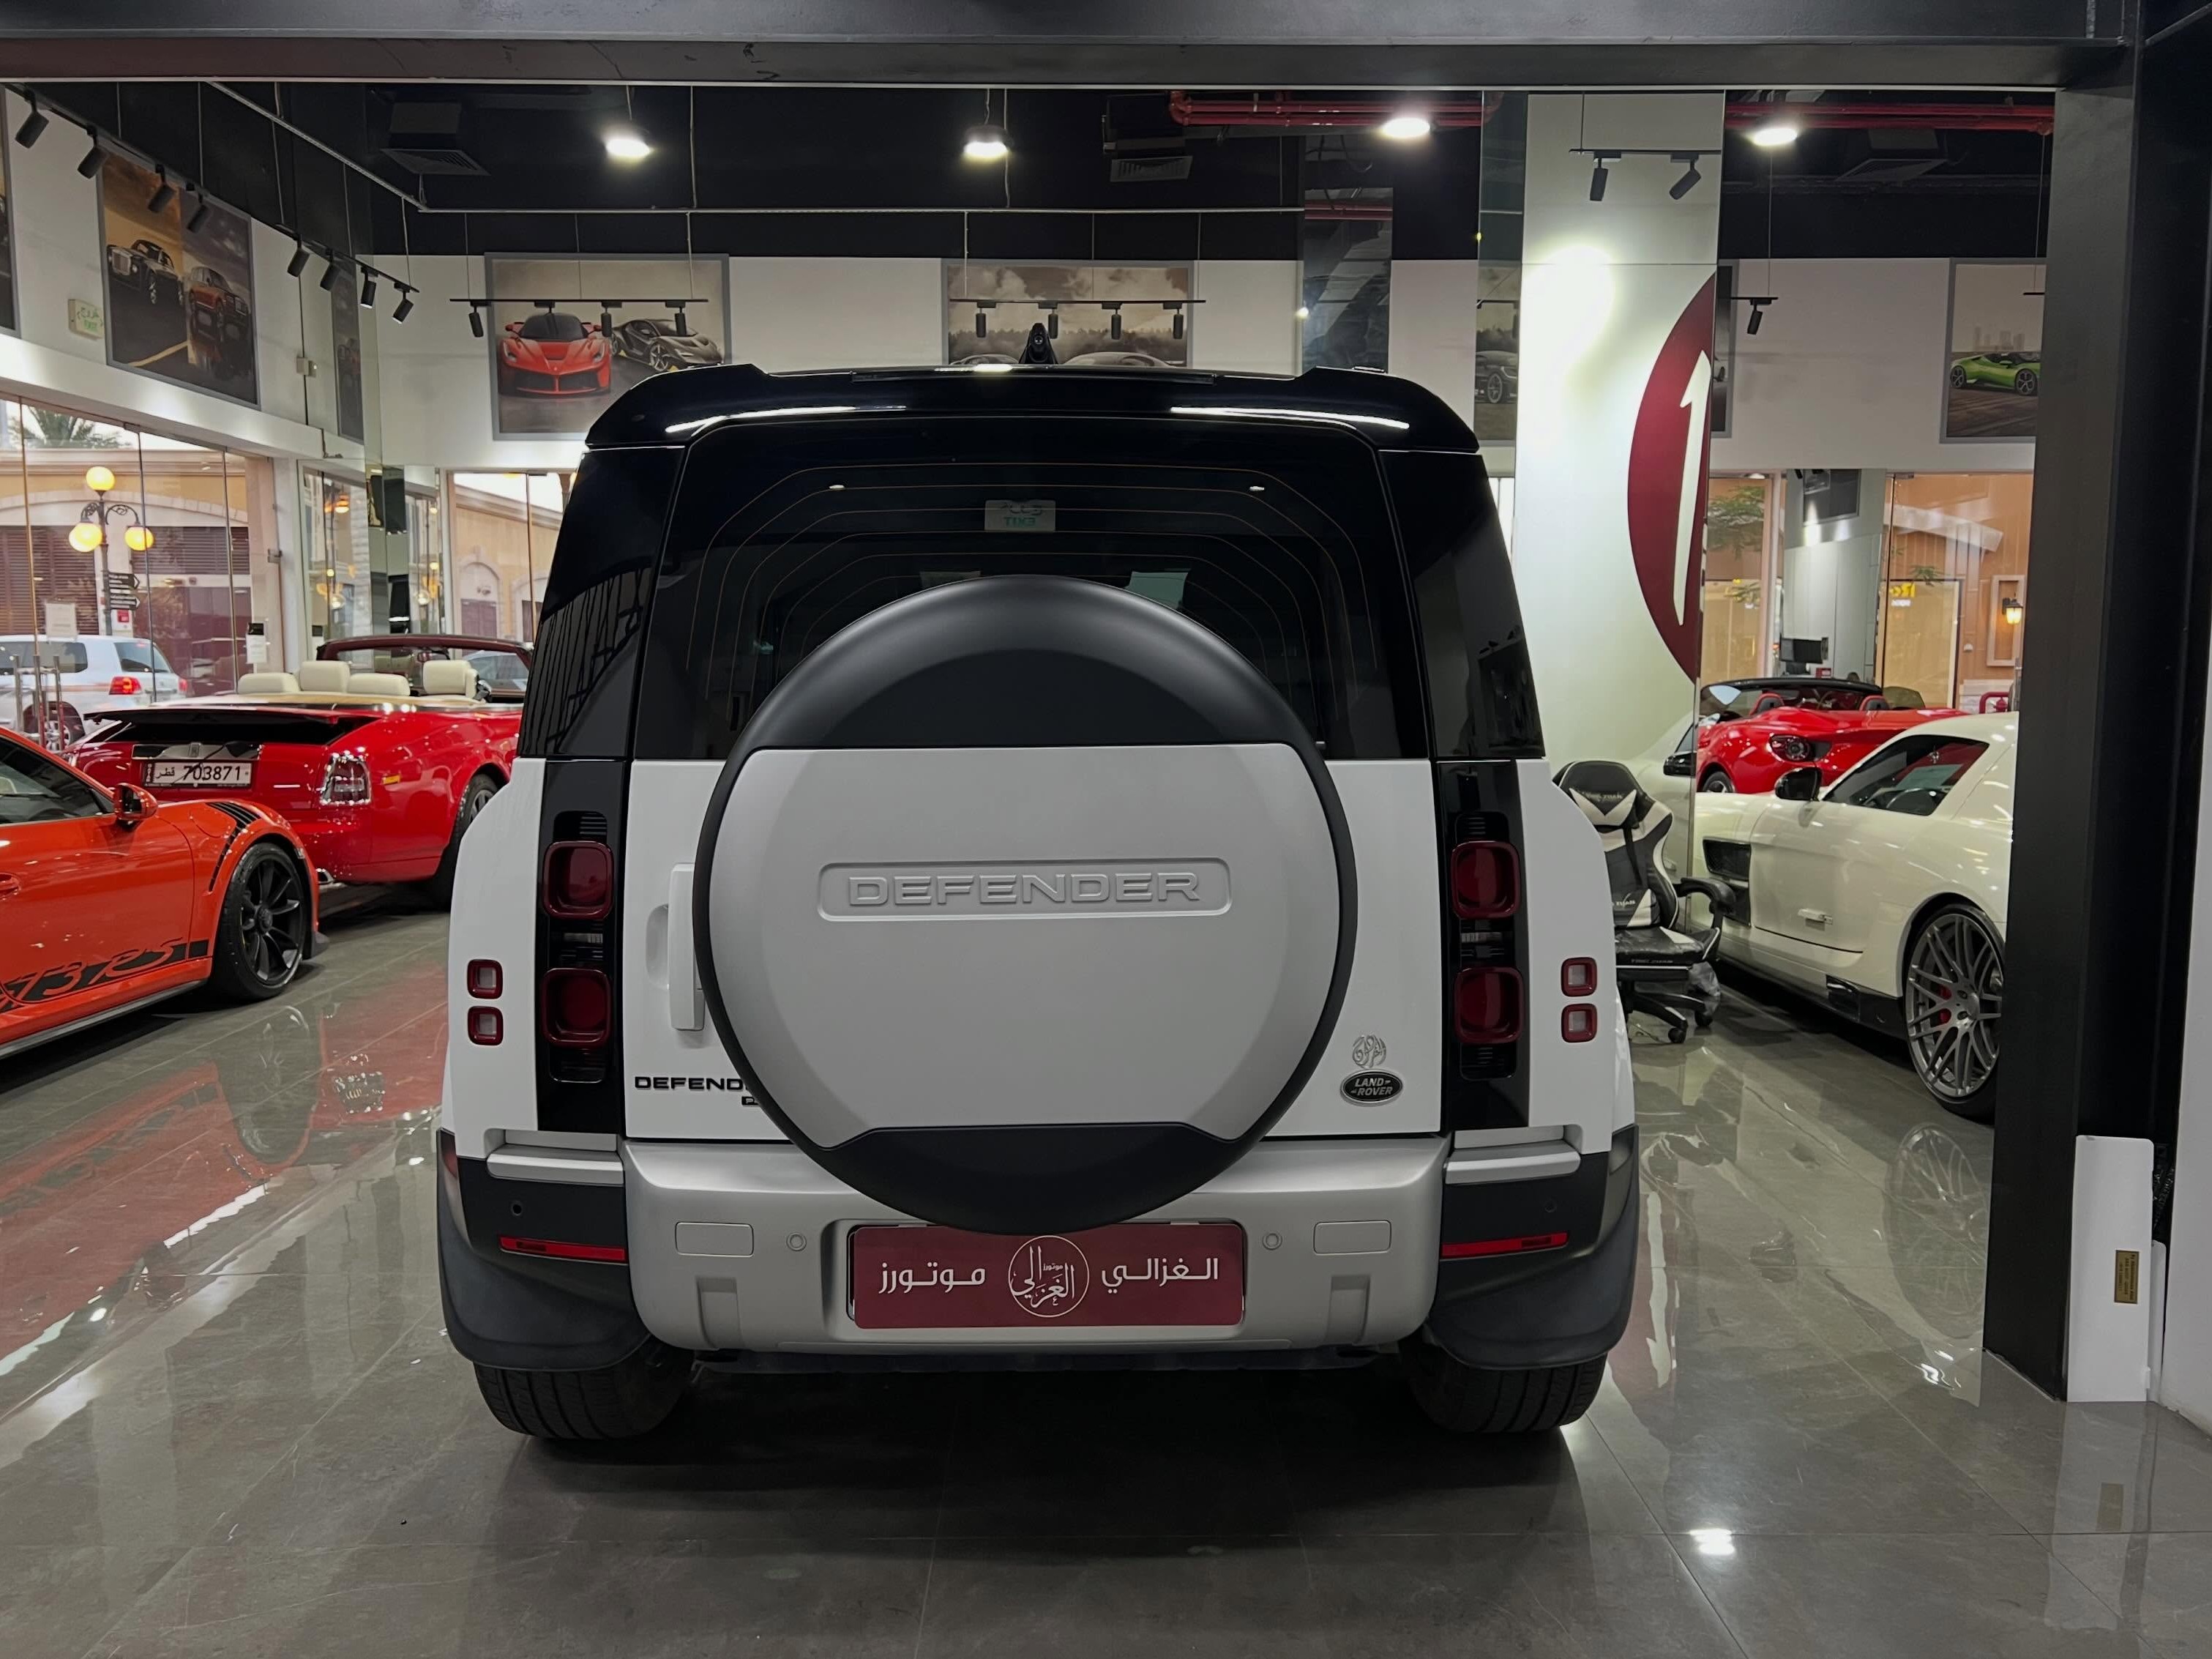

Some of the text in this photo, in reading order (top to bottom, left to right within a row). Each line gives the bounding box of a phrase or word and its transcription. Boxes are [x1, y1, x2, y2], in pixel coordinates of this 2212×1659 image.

[156, 767, 175, 779] قطر
[183, 766, 241, 780] 703871
[849, 873, 1200, 906] DEFENDER
[635, 1076, 747, 1090] DEFEND
[1355, 1078, 1384, 1087] LAND
[1357, 1086, 1393, 1096] ROVER
[878, 1258, 1218, 1294] الغزالي موتورز
